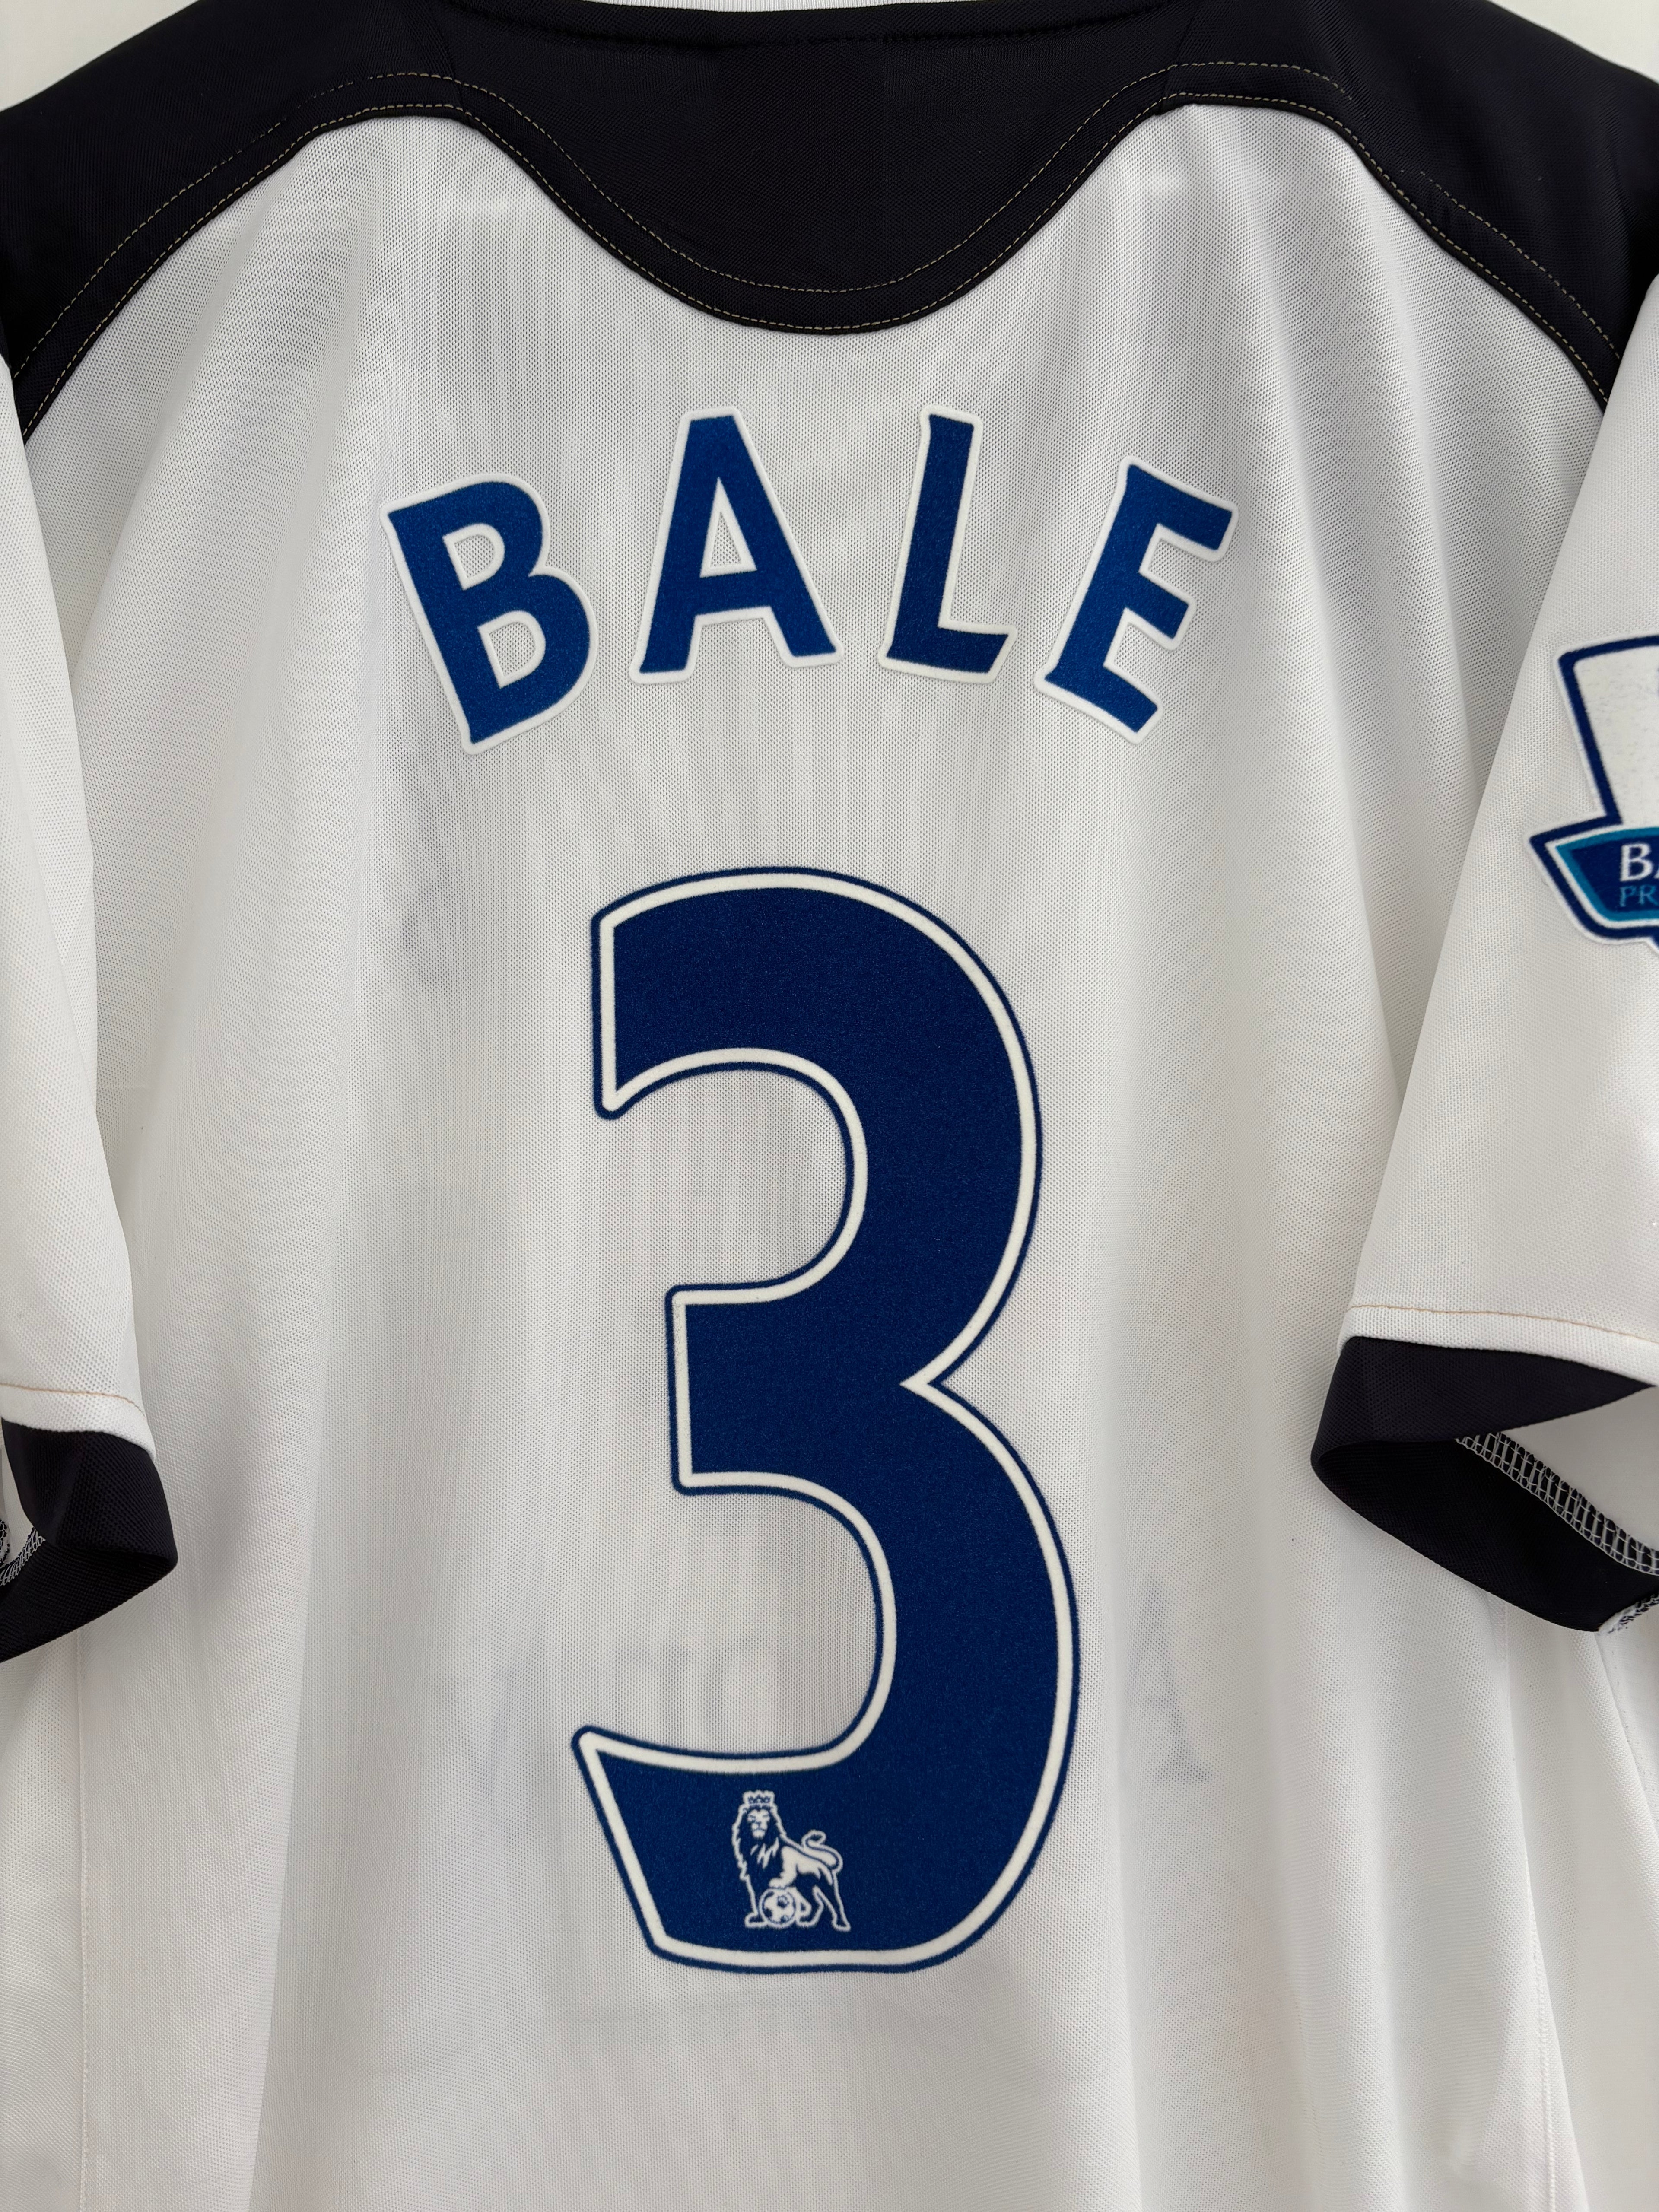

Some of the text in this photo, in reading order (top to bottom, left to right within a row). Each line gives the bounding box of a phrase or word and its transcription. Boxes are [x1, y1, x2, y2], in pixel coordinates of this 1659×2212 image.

[388, 414, 1232, 744] BALE
[1620, 842, 1659, 882] B
[572, 867, 1080, 1974] 3
